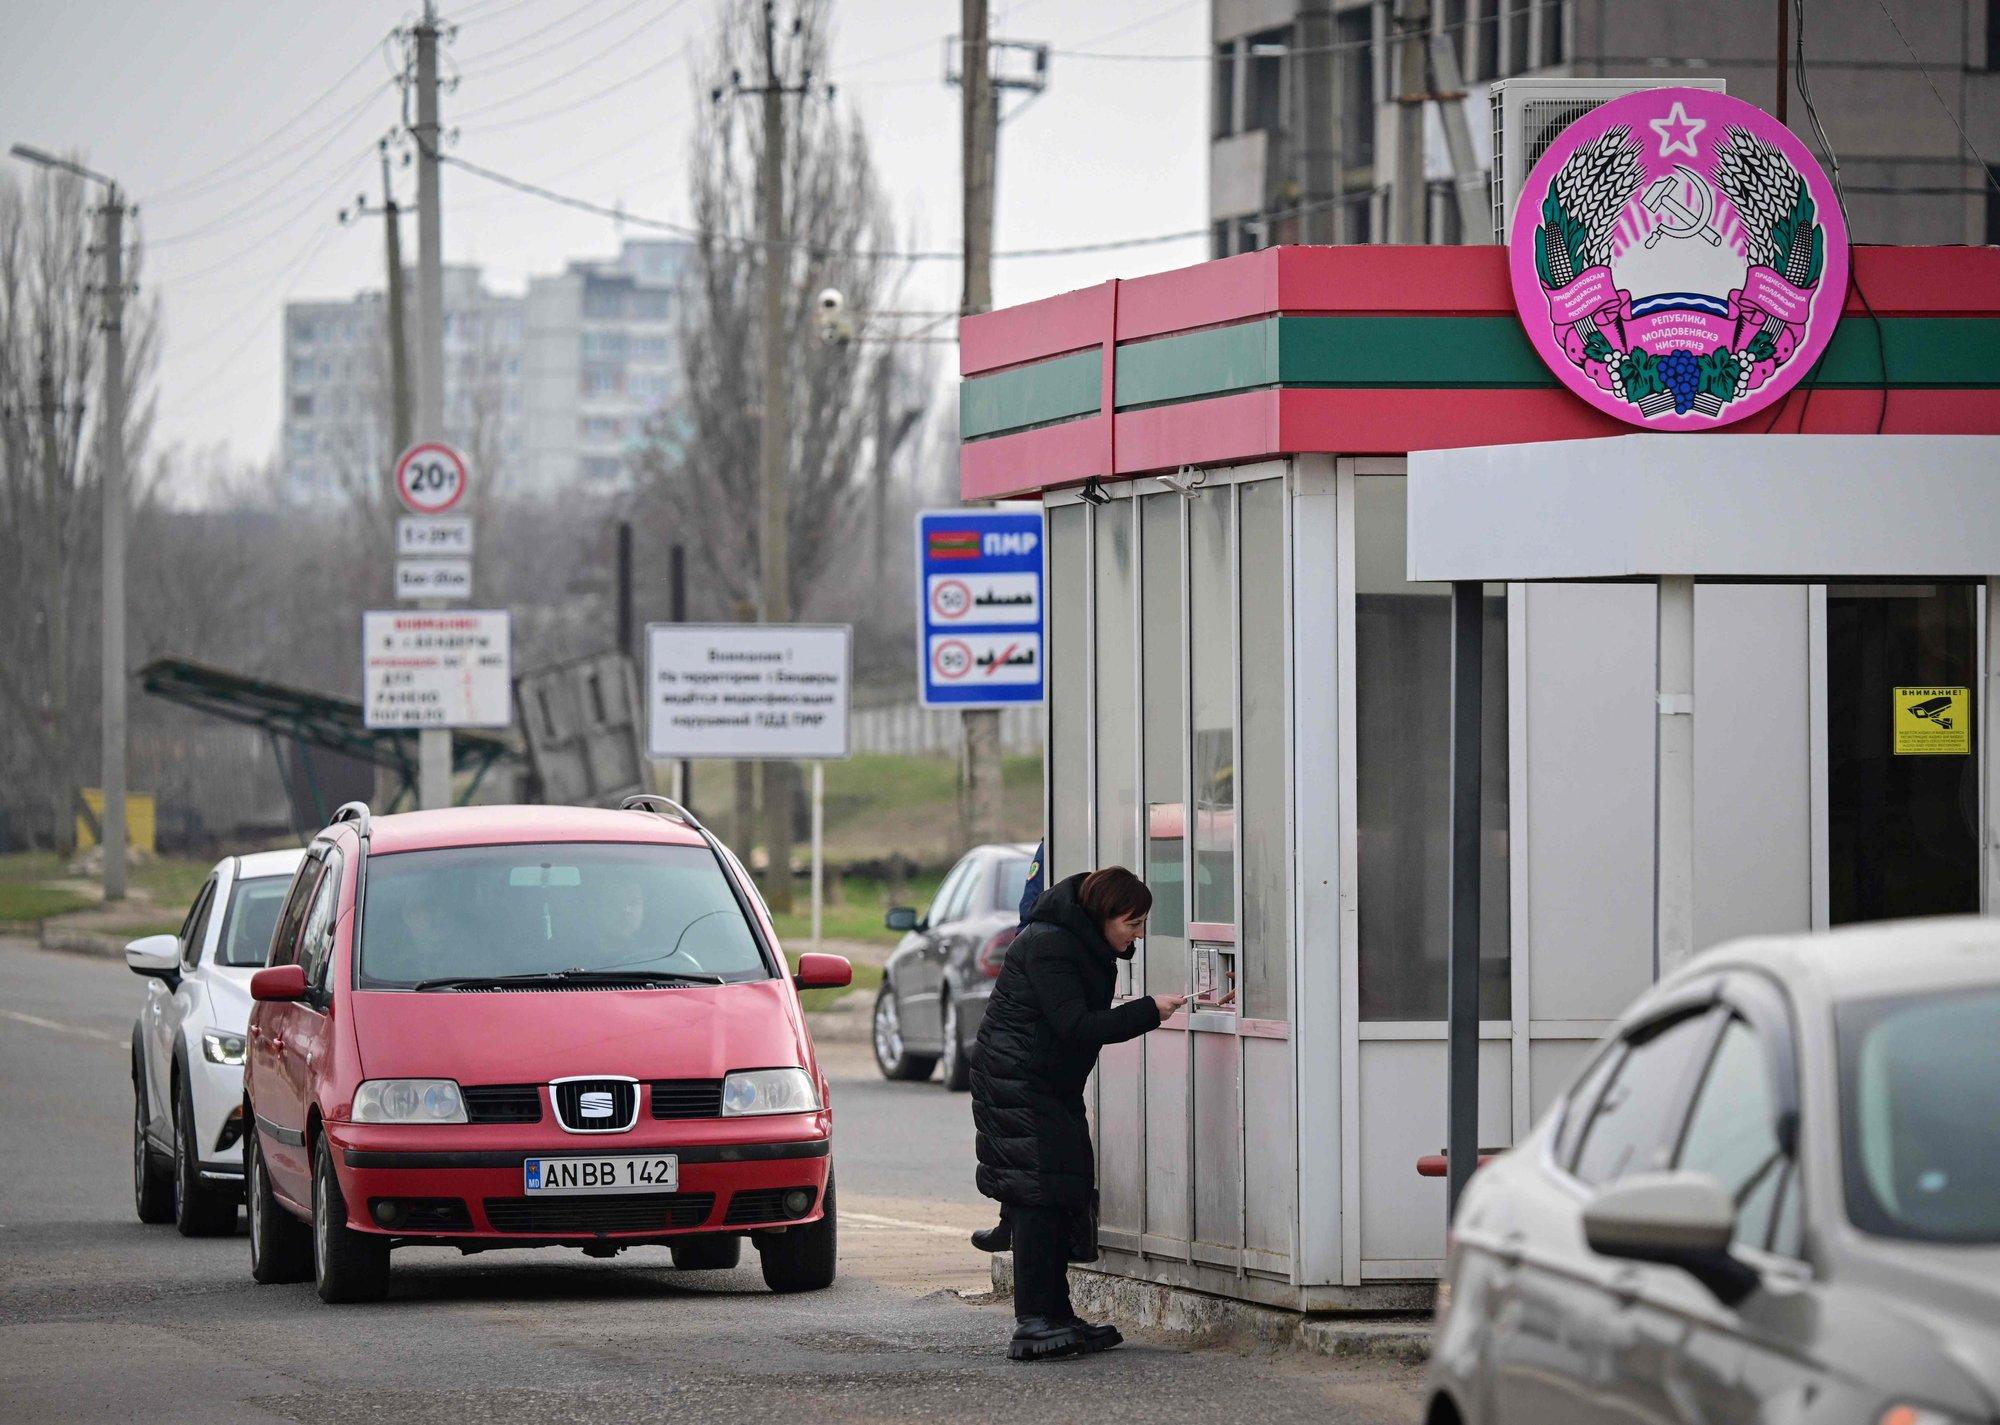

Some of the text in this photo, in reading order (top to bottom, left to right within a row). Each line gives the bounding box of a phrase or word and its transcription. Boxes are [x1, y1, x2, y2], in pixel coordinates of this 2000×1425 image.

[1553, 272, 1605, 302] ПРИДНЕСТРОВСКАЯ
[1565, 283, 1602, 308] МОЛДАВСКАЯ
[1568, 294, 1602, 318] РЕСПУБЛИКА
[1651, 313, 1706, 326] РЕПУБЛИКА
[1641, 327, 1719, 342] МОЛДОВЕНЯСКЭ
[1655, 339, 1704, 350] НИСТРЯНЭ
[983, 532, 1039, 556] ПМР
[528, 1179, 540, 1188] MD
[544, 1160, 669, 1188] ANBB 142
